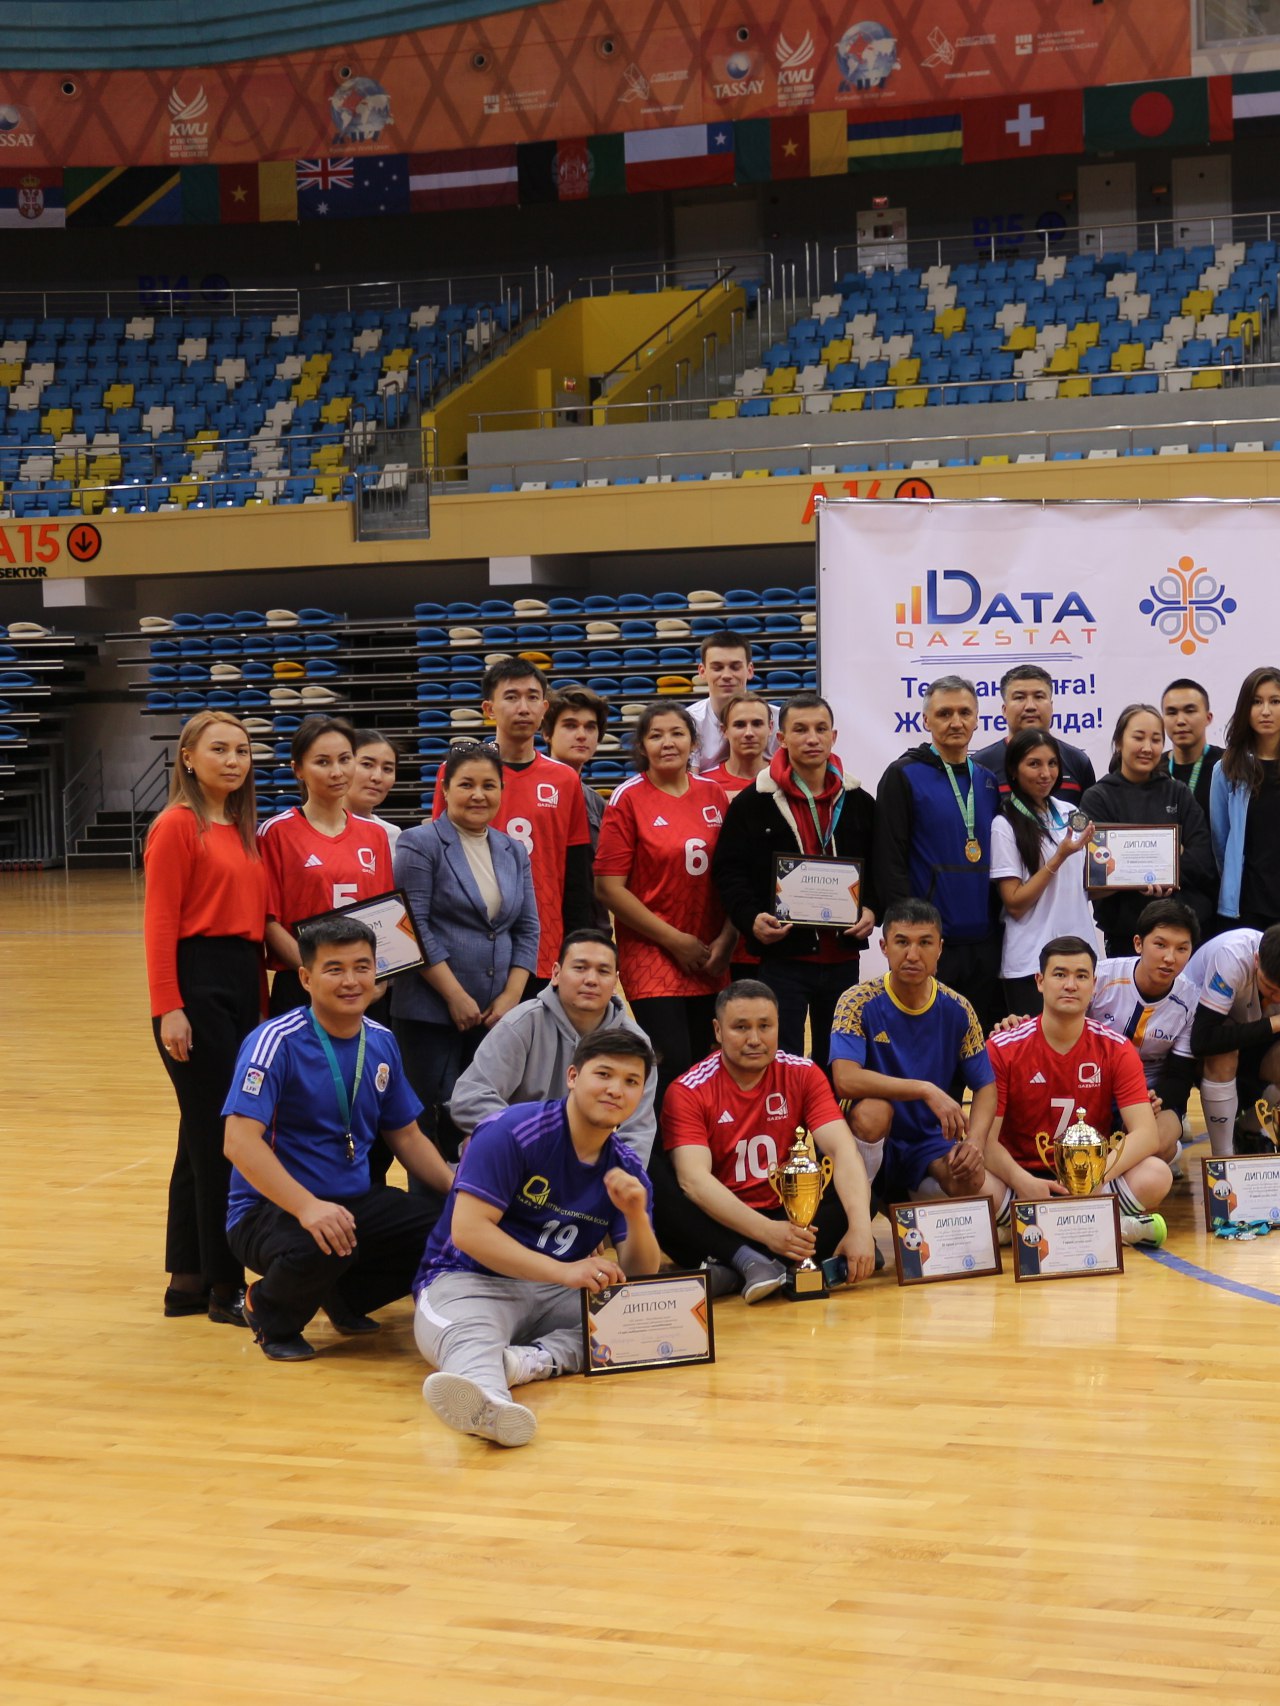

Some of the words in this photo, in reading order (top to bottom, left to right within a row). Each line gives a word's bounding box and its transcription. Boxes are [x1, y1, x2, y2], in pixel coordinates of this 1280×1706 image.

[777, 68, 815, 85] KWU
[713, 80, 765, 99] TASSAY
[169, 122, 208, 137] KWU
[0, 567, 48, 578] SEKTOR
[927, 570, 1097, 625] DATA
[896, 628, 1097, 649] QAZSTAT
[1052, 674, 1096, 695] лға!
[1050, 708, 1103, 734] лда!
[506, 817, 534, 857] 8
[1123, 839, 1158, 849] ДИПЛОМ
[684, 838, 709, 876] 6
[800, 874, 839, 886] ДИПЛОМ
[333, 883, 358, 909] 5
[1050, 1098, 1076, 1139] 7
[734, 1134, 778, 1182] 10
[1244, 1170, 1280, 1182] ДИПЛОМ
[935, 1215, 973, 1229] ДИПЛОМ
[1056, 1213, 1096, 1226] ДИПЛОМ
[537, 1219, 579, 1256] 19
[623, 1300, 677, 1315] ДИПЛОМ
